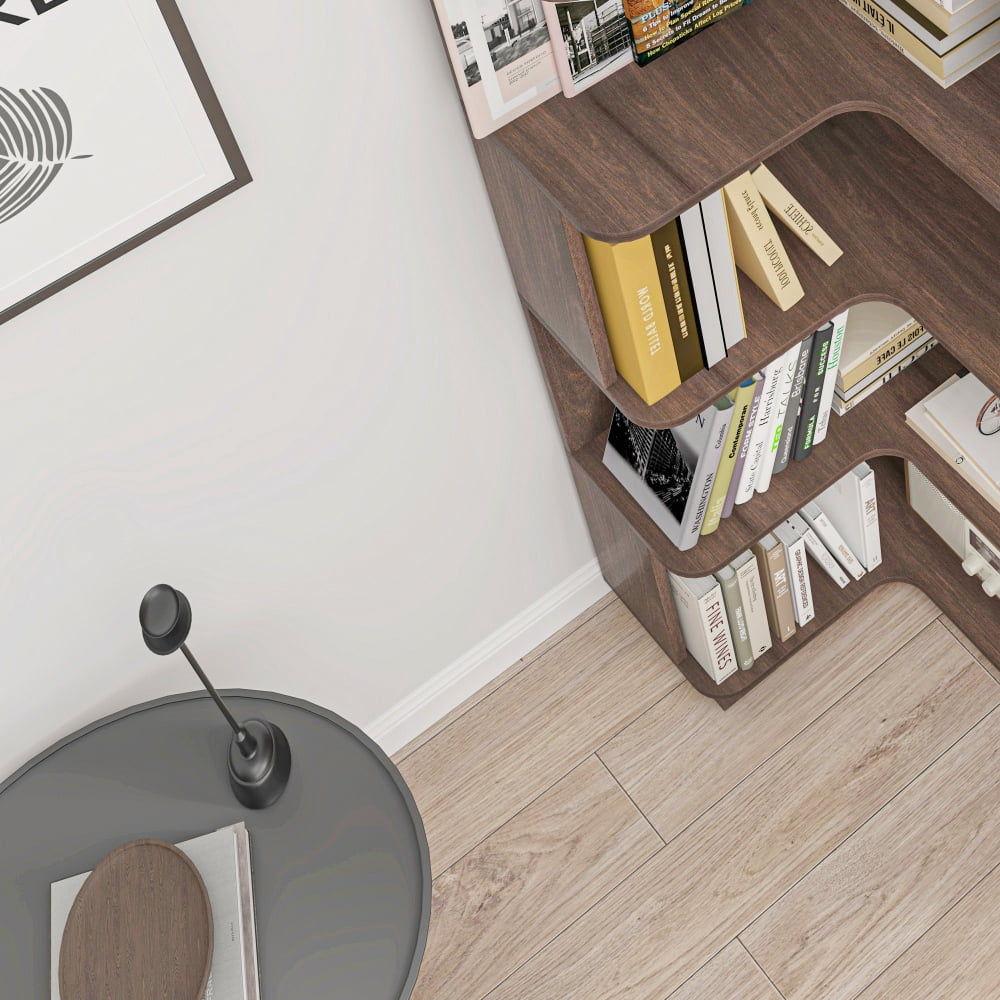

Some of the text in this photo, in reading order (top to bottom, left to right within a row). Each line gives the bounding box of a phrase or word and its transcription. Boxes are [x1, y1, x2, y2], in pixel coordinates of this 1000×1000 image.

[887, 19, 895, 35] IL
[647, 48, 661, 58] How
[791, 348, 809, 398] Brisbane
[827, 325, 844, 371] Houston
[759, 367, 783, 427] Harrisburg
[691, 472, 714, 534] WASHINGTON
[705, 600, 732, 671] FINE WINES
